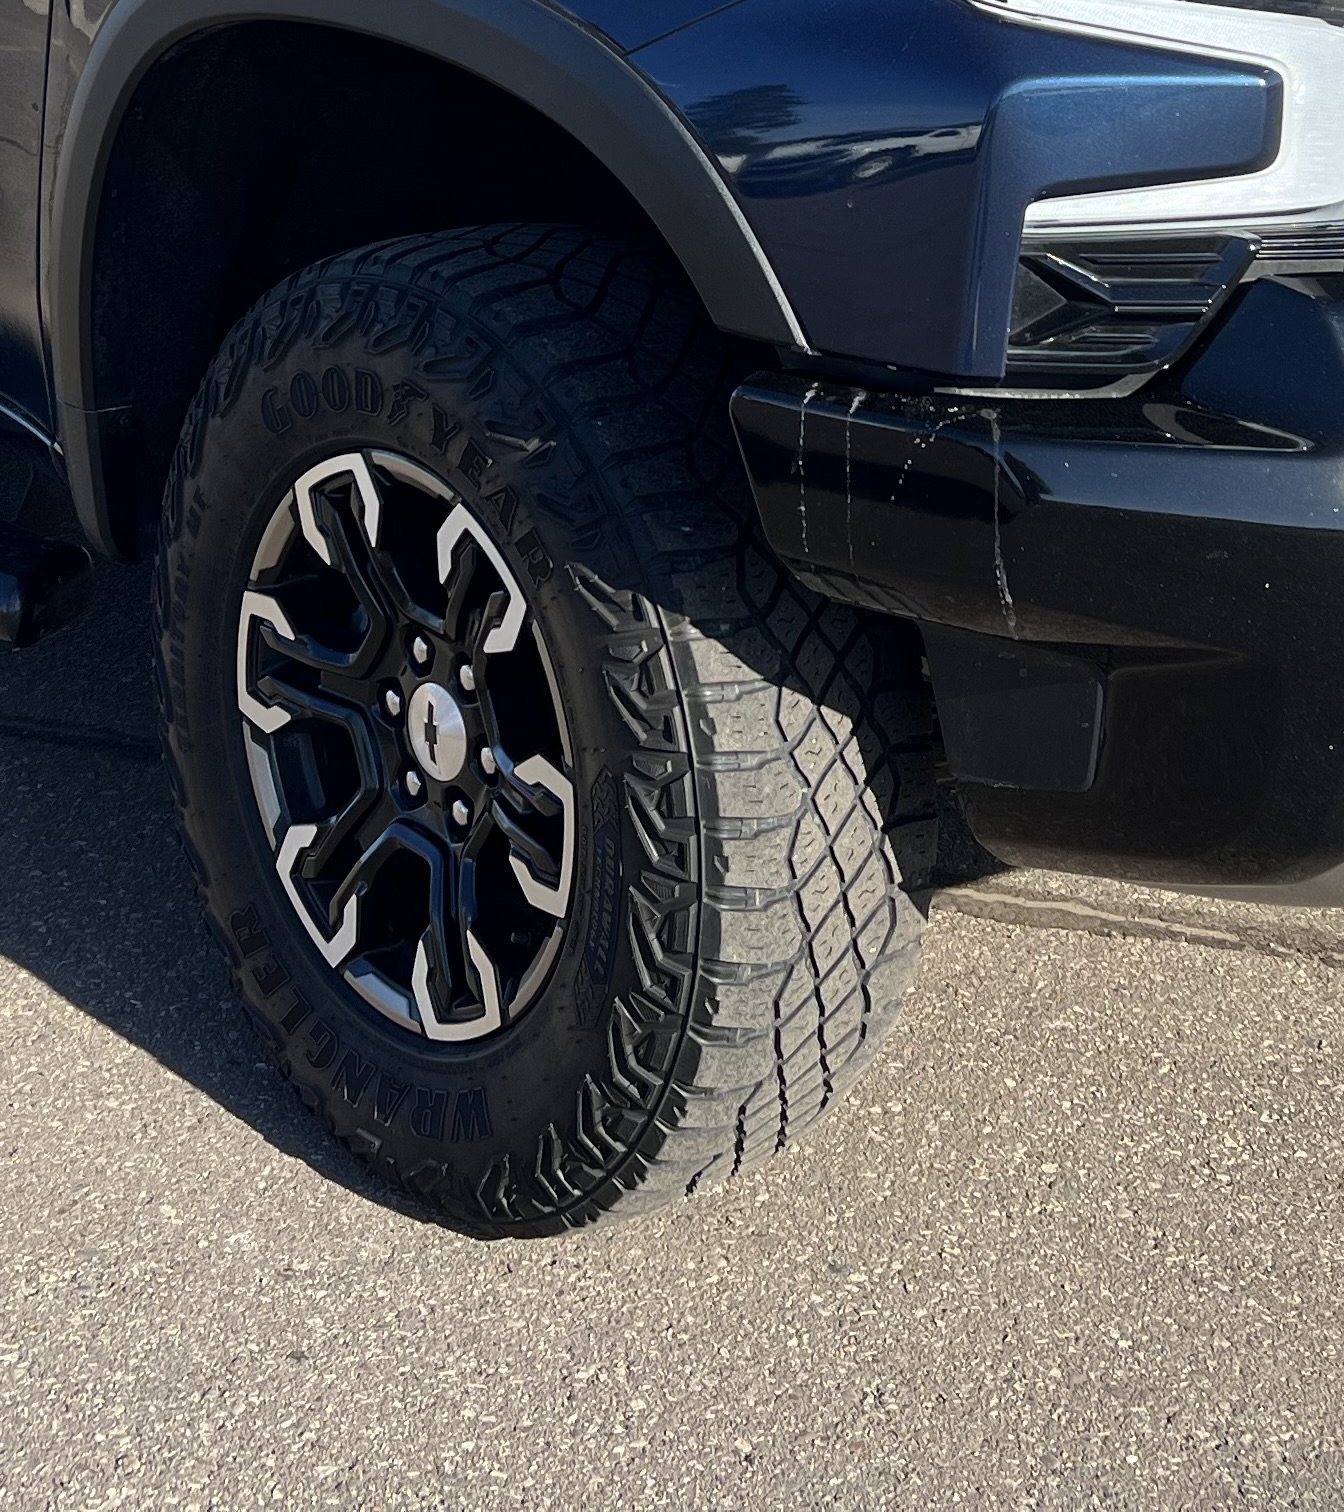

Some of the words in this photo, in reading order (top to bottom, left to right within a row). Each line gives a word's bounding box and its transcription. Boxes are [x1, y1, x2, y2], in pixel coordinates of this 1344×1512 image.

[260, 364, 555, 591] GOODYEAR
[593, 835, 616, 978] DURAWALL
[229, 901, 494, 1143] WRANGLER
